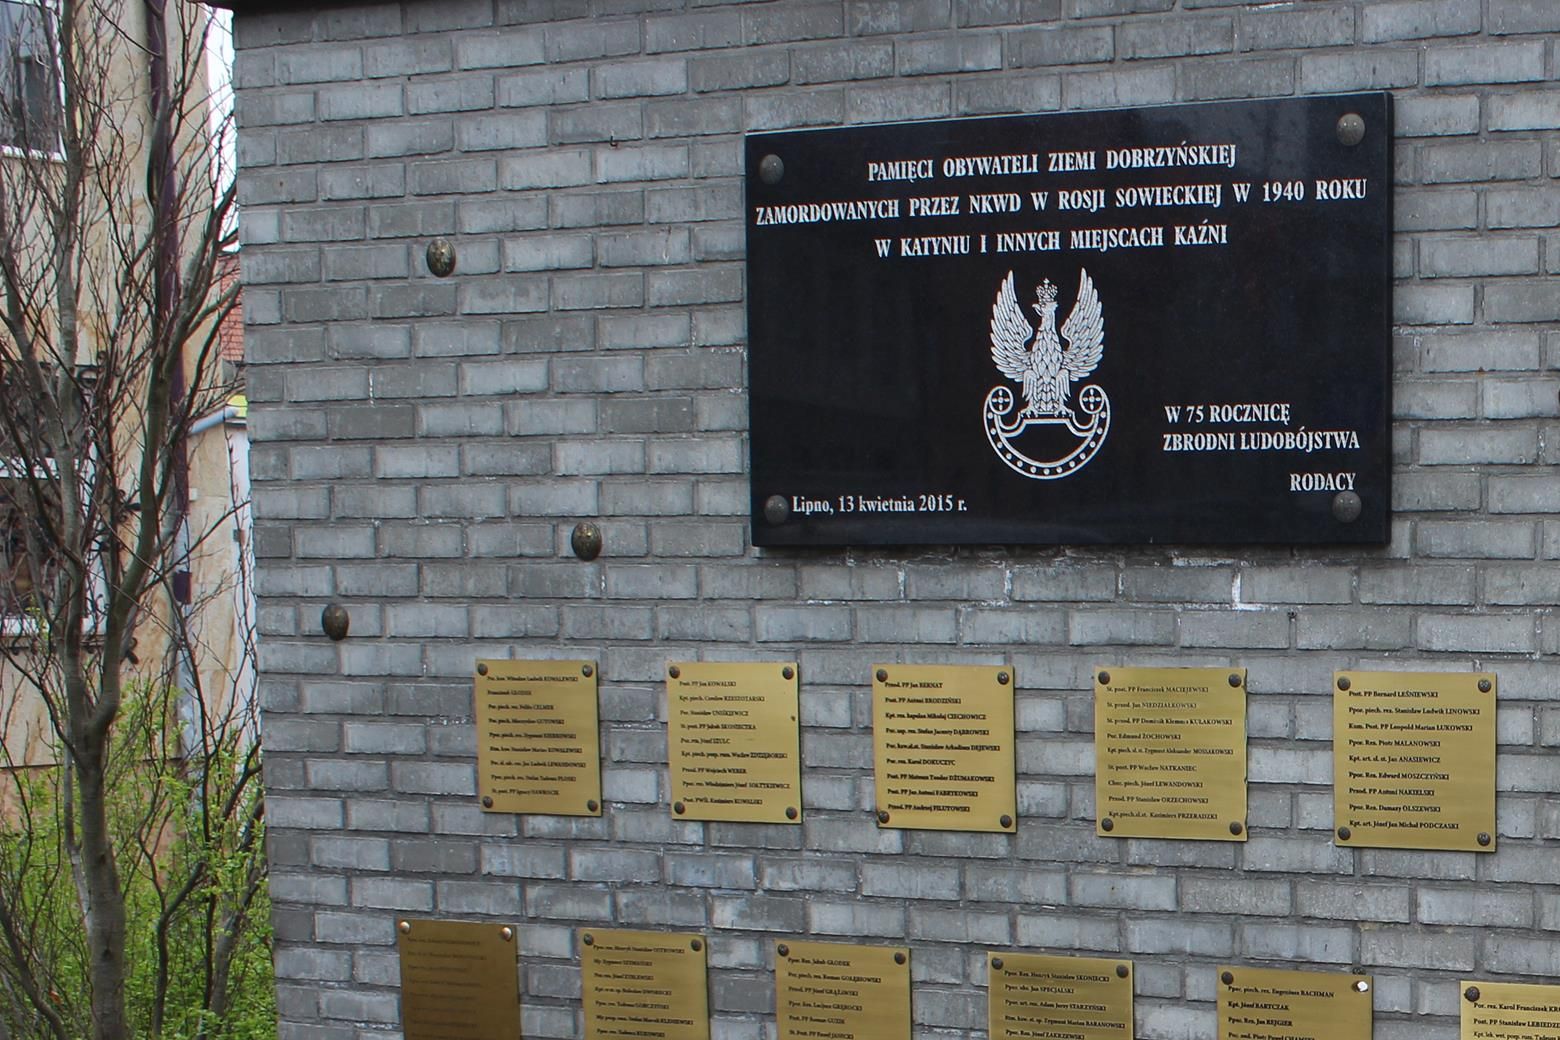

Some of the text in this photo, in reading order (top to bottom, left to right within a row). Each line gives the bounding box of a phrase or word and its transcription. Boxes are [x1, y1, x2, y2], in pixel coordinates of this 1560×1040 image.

[868, 144, 1236, 183] PAMIĘCI OBYWATELI ZIEMI DOBRZYŃSKIEJ
[756, 179, 1367, 225] ZAMORDOWANYCH PRZEZ NKWD W ROSJI SOWIECKIEJ W 1940 ROKU
[875, 219, 1227, 257] W KATYNIU I INNYCH MIEJSCACH KAŹNI
[1164, 403, 1290, 425] W 75 ROCZNICĘ
[1163, 426, 1360, 453] ZBRODNI LUDOBÓJSTWA
[1290, 473, 1356, 491] RODACY
[793, 496, 834, 515] Lipno,
[839, 496, 854, 512] 13
[859, 496, 915, 512] kwietnia
[919, 495, 953, 511] 2015
